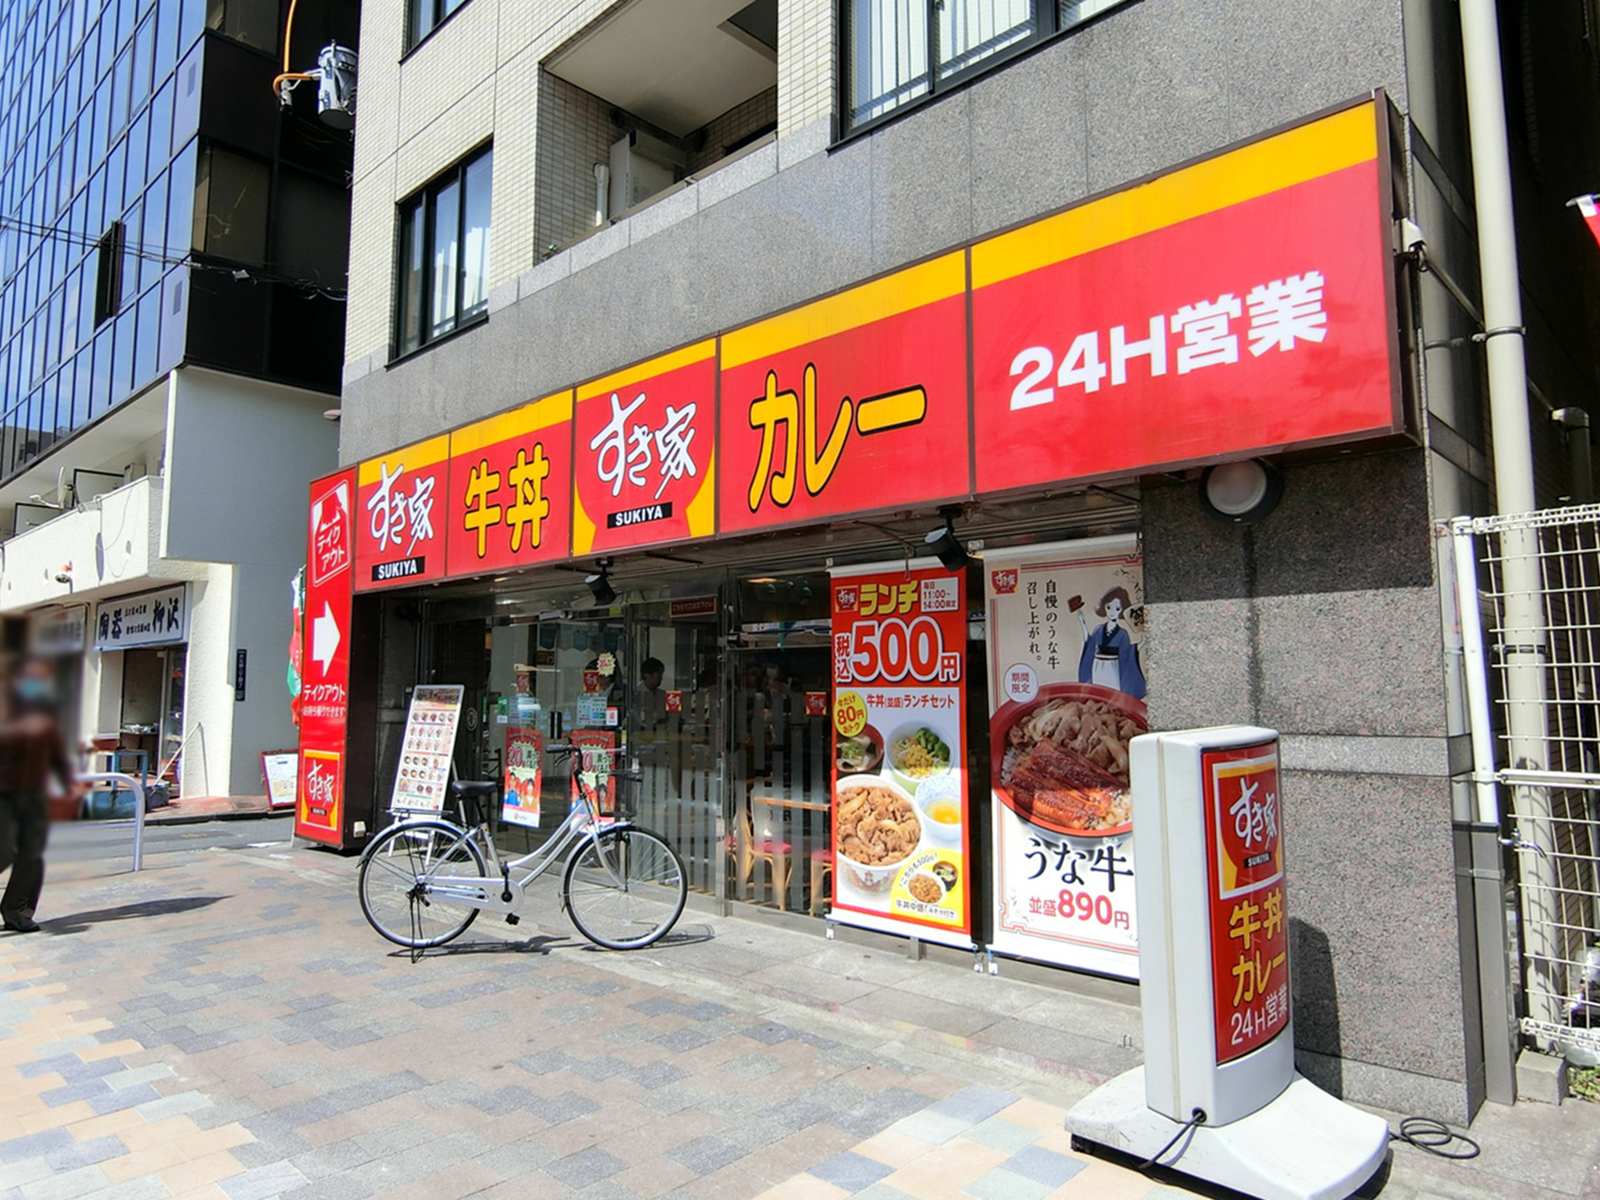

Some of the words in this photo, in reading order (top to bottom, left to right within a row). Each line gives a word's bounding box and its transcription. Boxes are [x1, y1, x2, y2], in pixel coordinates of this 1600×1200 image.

[1009, 270, 1328, 411] 24H営業
[589, 392, 697, 500] すき家
[747, 362, 928, 514] カレー
[366, 462, 435, 557] すき家
[464, 442, 550, 558] 牛丼
[614, 504, 663, 527] SUKIYA
[317, 525, 341, 554] テイク
[321, 545, 345, 572] アウト
[376, 558, 418, 580] SUKIYA
[860, 580, 918, 616] ランチ
[1026, 581, 1042, 661] 召し上がれ。
[852, 616, 960, 682] 500円
[1044, 579, 1060, 670] 自慢のうな牛
[835, 633, 851, 682] 税込
[1011, 672, 1030, 683] 期間
[304, 683, 346, 701] テイクアウト
[837, 694, 856, 707] 今だけ
[866, 694, 955, 709] 牛丼(並盛)ランチセット
[1011, 683, 1030, 694] 限定
[836, 705, 865, 726] 80円
[306, 759, 335, 807] すき家
[1229, 777, 1278, 850] すき家
[1024, 837, 1135, 893] うな牛
[1028, 889, 1130, 930] 並盛890円
[1229, 887, 1283, 950] 牛丼
[1232, 950, 1286, 1008] カレー
[1230, 983, 1288, 1046] 24H営業
